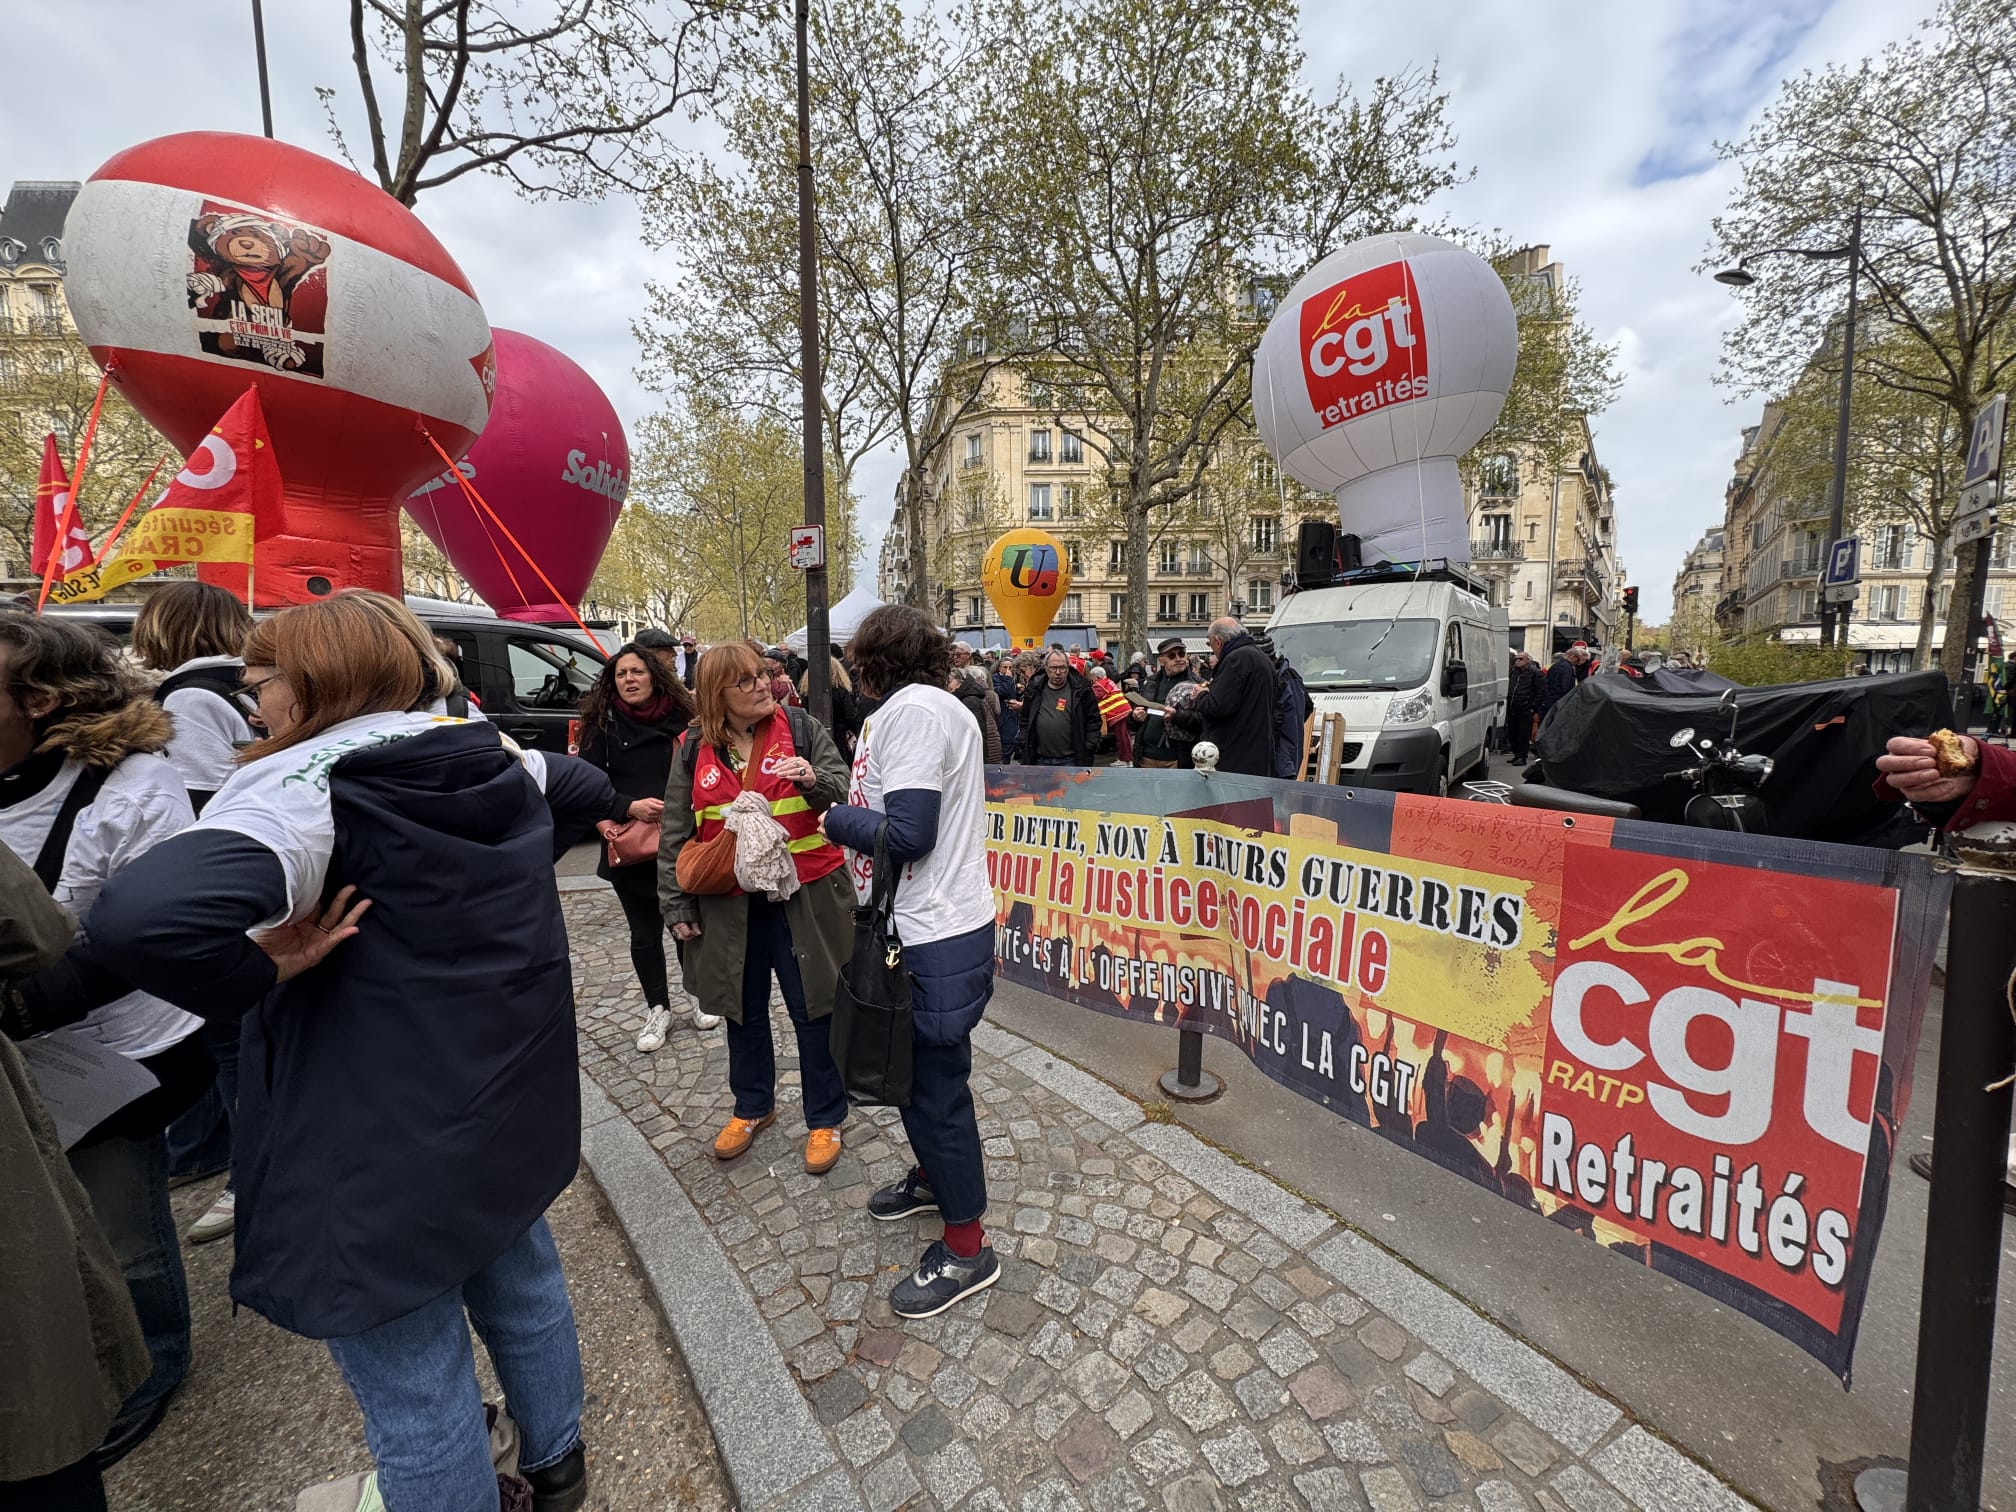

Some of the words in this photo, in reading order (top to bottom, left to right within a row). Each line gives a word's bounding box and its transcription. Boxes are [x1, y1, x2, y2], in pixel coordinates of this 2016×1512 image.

[230, 299, 247, 321] LA
[281, 327, 292, 340] VIE
[1310, 296, 1416, 377] cgt
[1315, 372, 1429, 427] retraités
[1973, 420, 1993, 469] P
[1835, 547, 1850, 577] P
[700, 767, 722, 788] cgt
[985, 812, 1005, 841] UR
[1012, 815, 1086, 857] DETTE,
[1096, 824, 1148, 861] NON
[1160, 821, 1180, 864] À
[1194, 832, 1287, 889] LEURS
[1301, 857, 1521, 946] GUERRES
[1048, 852, 1075, 905] la
[1082, 856, 1219, 929] justice
[1227, 889, 1388, 993] sociale
[1059, 937, 1070, 979] À
[1079, 948, 1236, 1017] L'OFFENSIVE
[1240, 988, 1287, 1055] AVEC
[1301, 1022, 1334, 1080] LA
[1350, 1044, 1415, 1115] CGT
[1547, 1060, 1645, 1109] RATP
[1551, 960, 1882, 1155] cgt
[1541, 1112, 1850, 1286] Retraités
